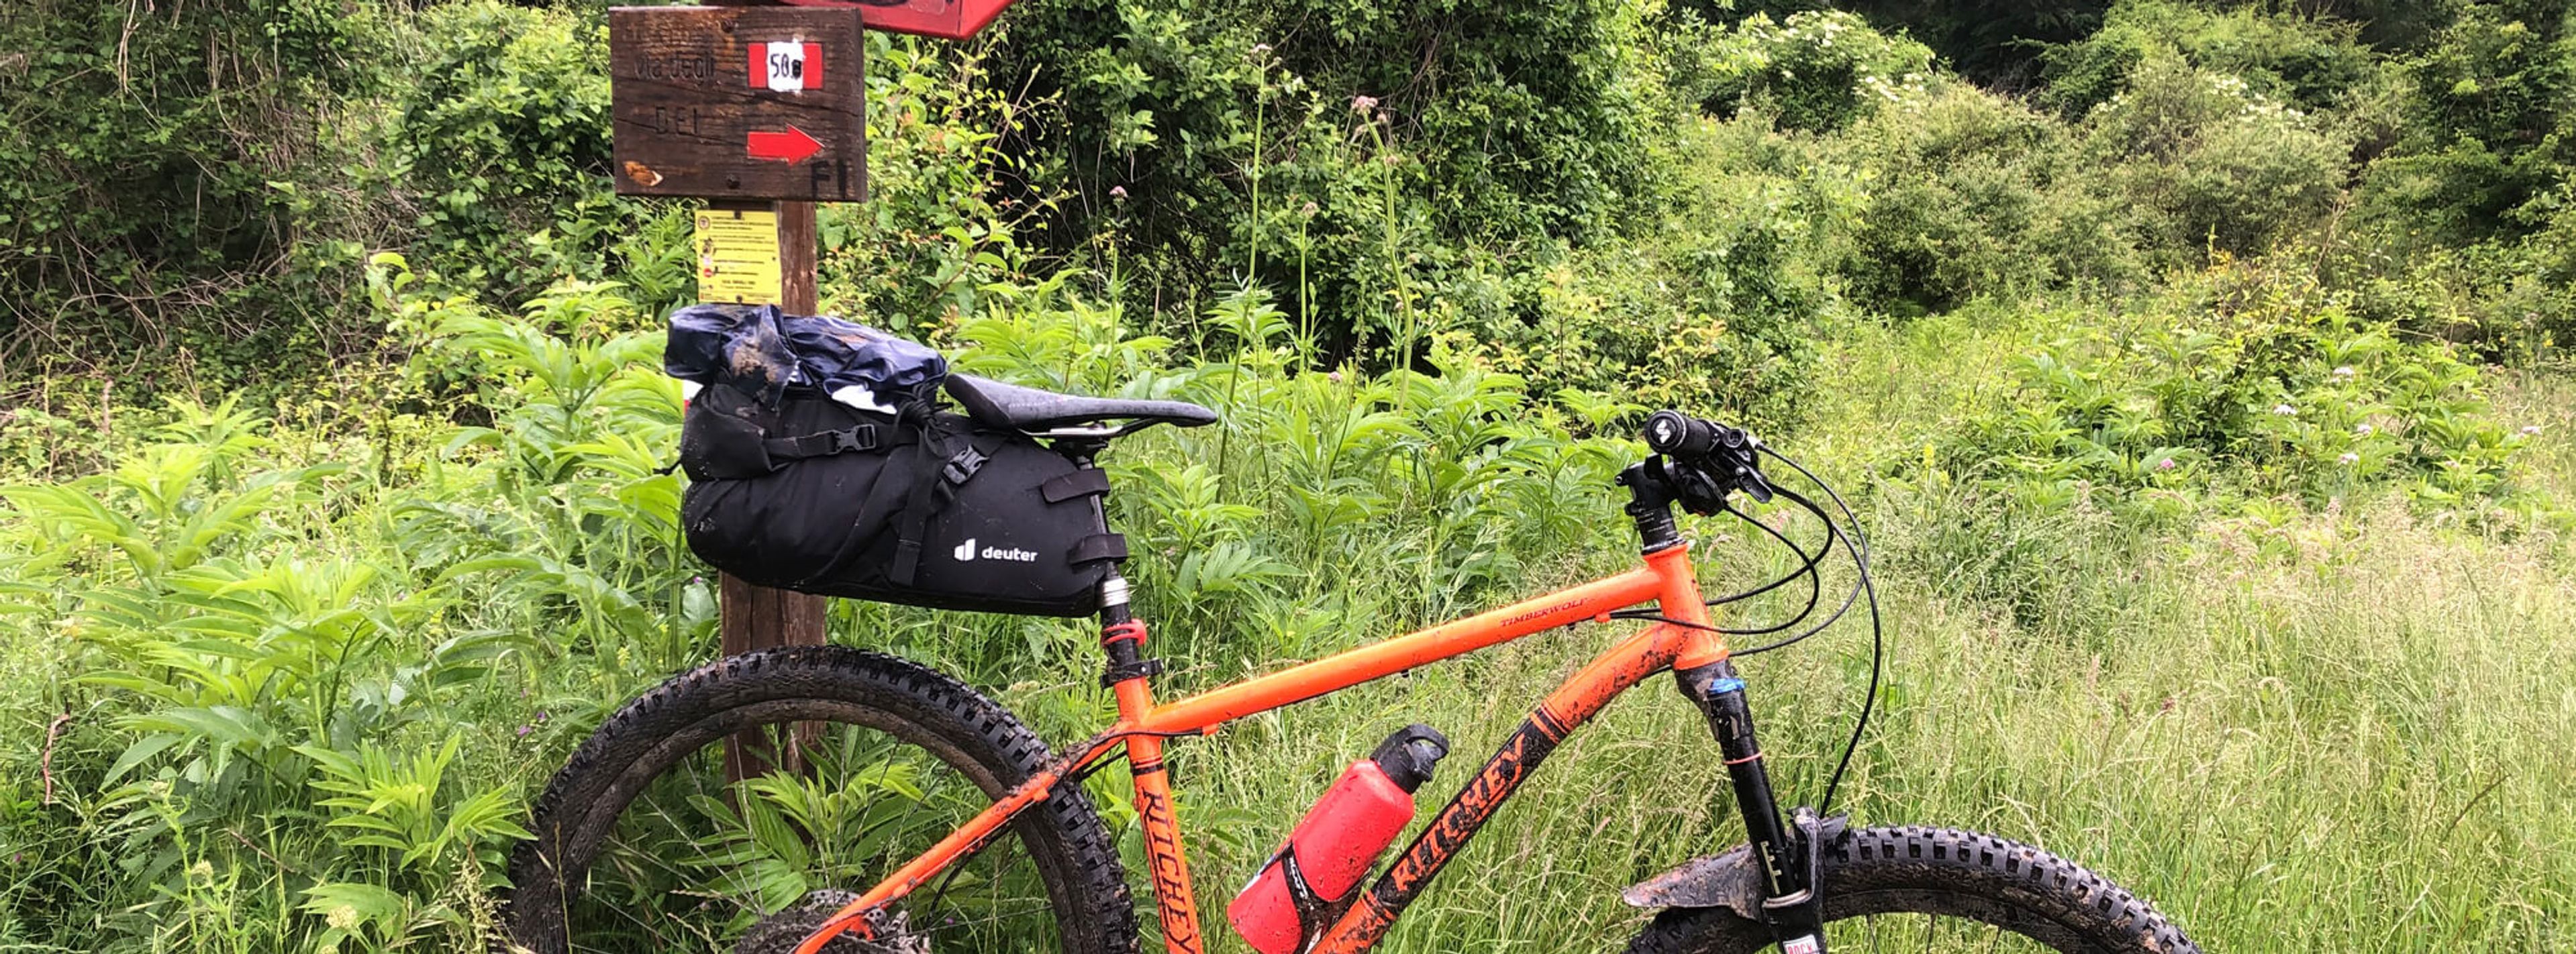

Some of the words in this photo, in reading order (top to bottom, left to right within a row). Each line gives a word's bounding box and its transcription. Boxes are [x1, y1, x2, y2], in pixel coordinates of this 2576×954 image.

[655, 106, 698, 135] DEI
[981, 546, 1038, 562] deuter
[1500, 597, 1588, 627] TIMBERWOLF
[1391, 733, 1525, 892] RITCHEY
[1142, 786, 1195, 954] RITCHEY
